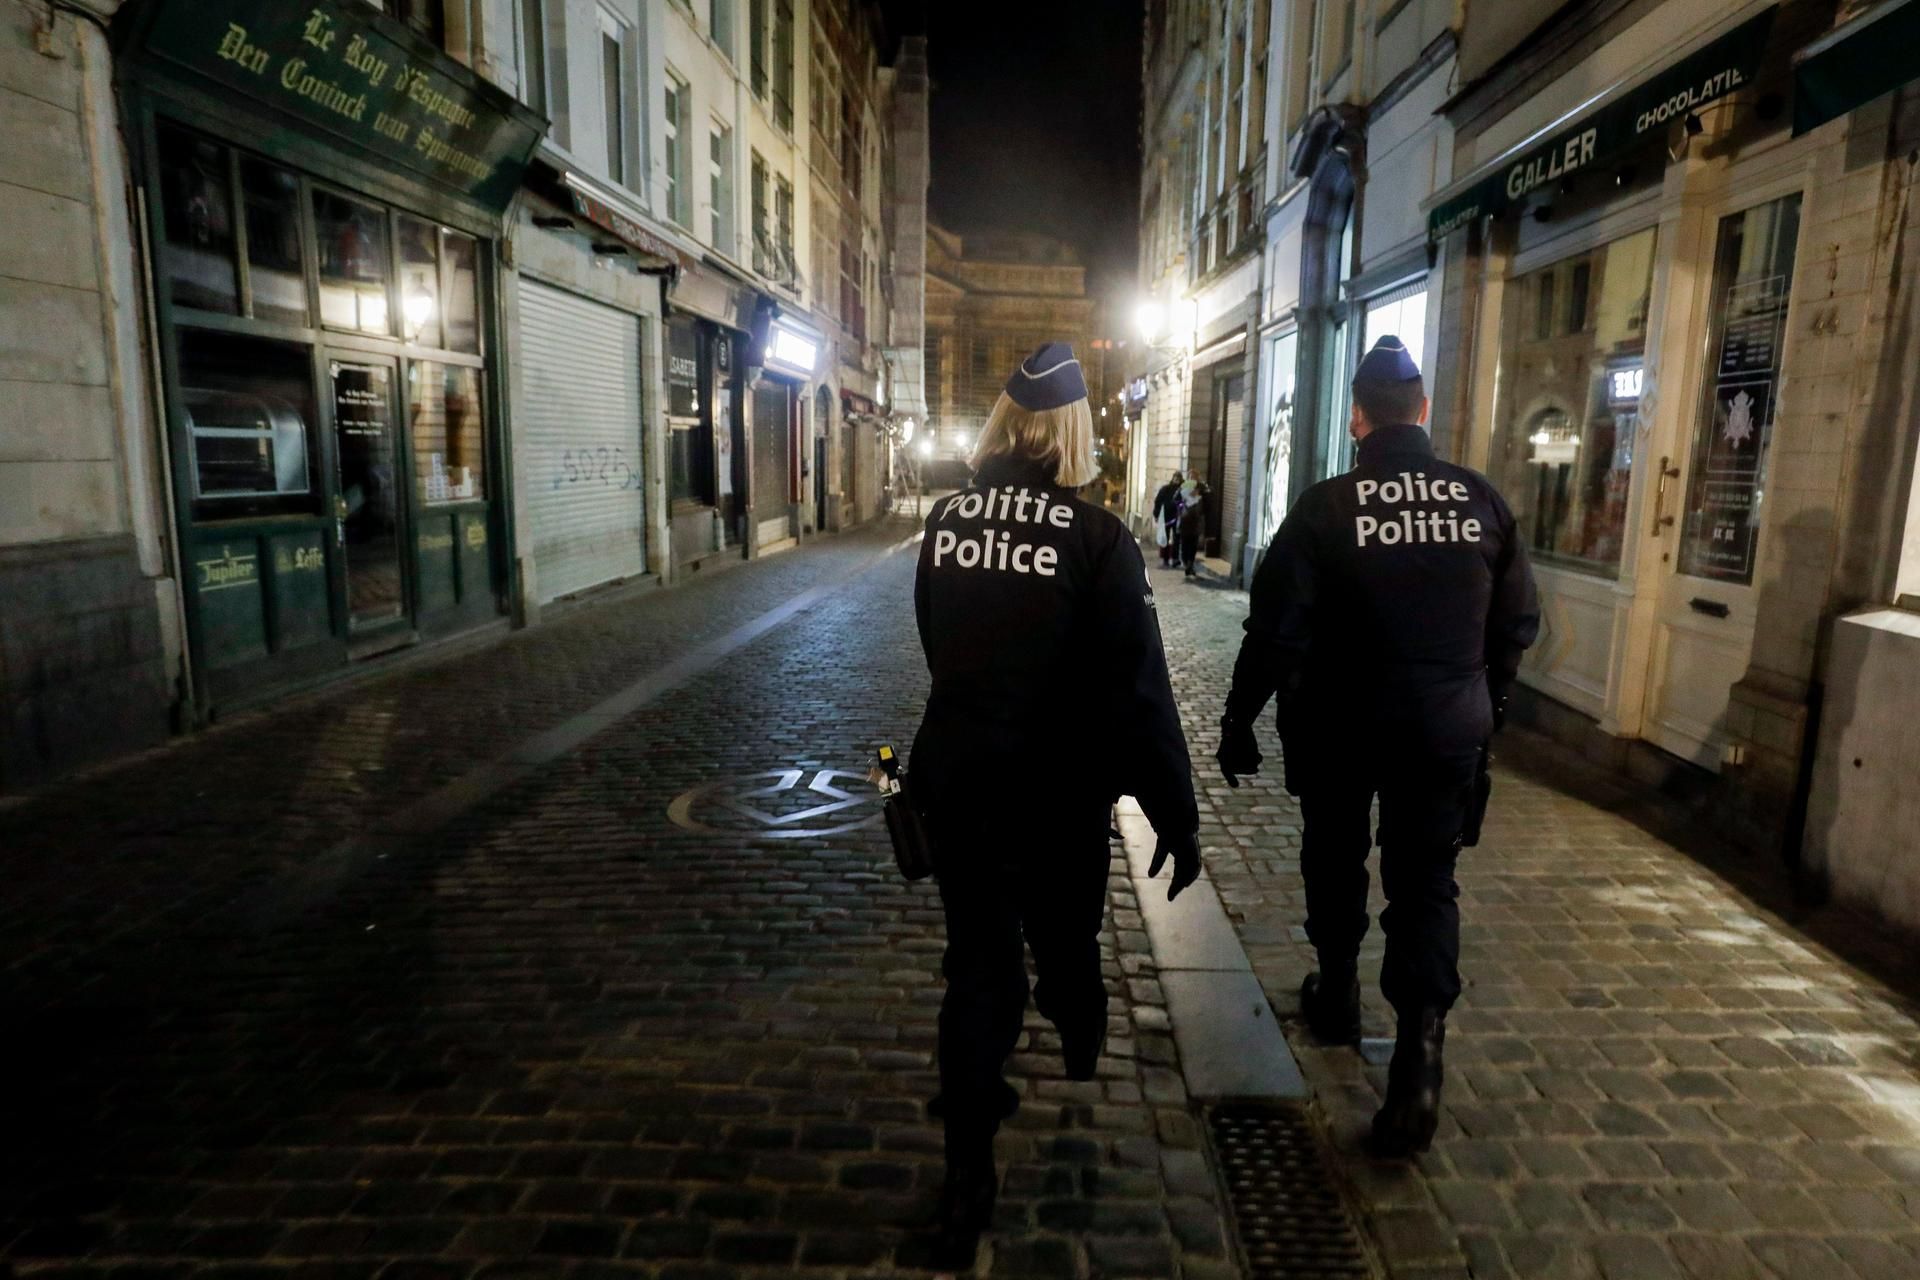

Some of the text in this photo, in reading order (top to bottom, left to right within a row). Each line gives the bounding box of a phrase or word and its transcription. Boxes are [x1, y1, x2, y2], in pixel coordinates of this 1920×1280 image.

[217, 22, 270, 75] Den
[303, 8, 335, 52] Le
[344, 33, 388, 86] Roy
[1506, 127, 1597, 200] GALLER
[1636, 67, 1748, 134] CHOCOLATIE
[938, 485, 1074, 528] Politie
[1356, 472, 1470, 506] Police
[1355, 510, 1482, 547] Politie
[934, 529, 1058, 576] Police
